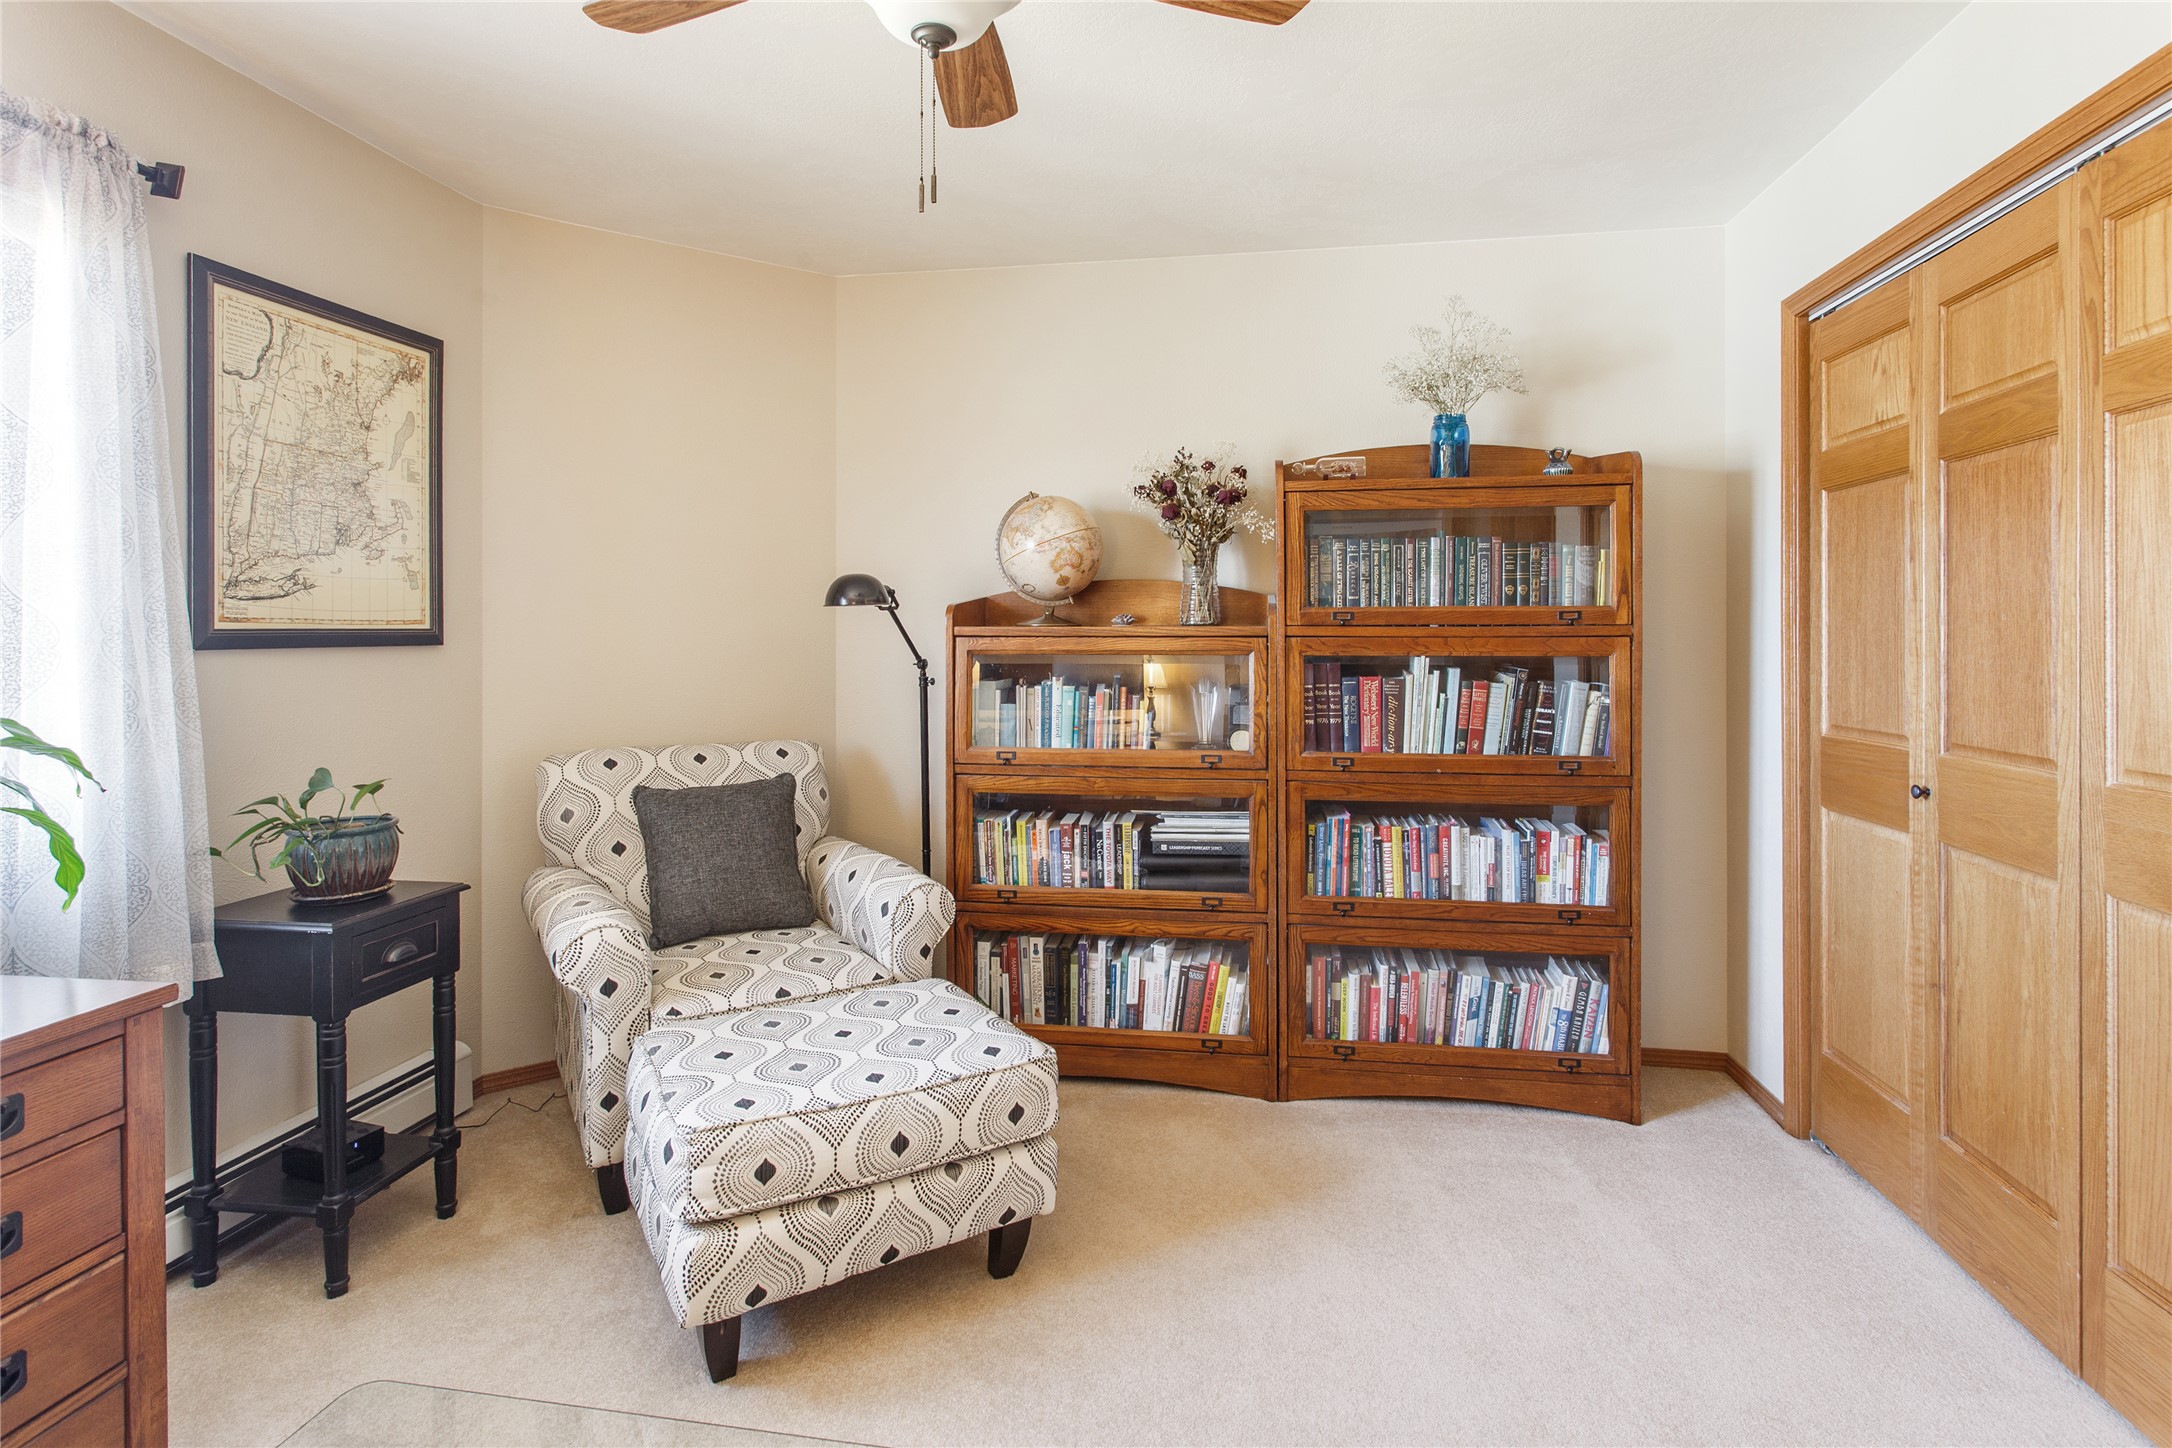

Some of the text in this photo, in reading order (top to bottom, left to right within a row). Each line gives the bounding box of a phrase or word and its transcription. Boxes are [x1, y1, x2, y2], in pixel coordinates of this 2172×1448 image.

[1362, 680, 1370, 715] Dictionary
[1097, 840, 1103, 848] No
[1062, 850, 1072, 869] jack
[1384, 845, 1392, 873] TOYOTA
[1206, 1004, 1210, 1013] TO
[1400, 983, 1408, 1015] RELENTLESS
[1556, 1019, 1569, 1034] 8th
[1570, 991, 1588, 1040] GEMBA KAIZEN
[1583, 998, 1600, 1039] KAIZEN
